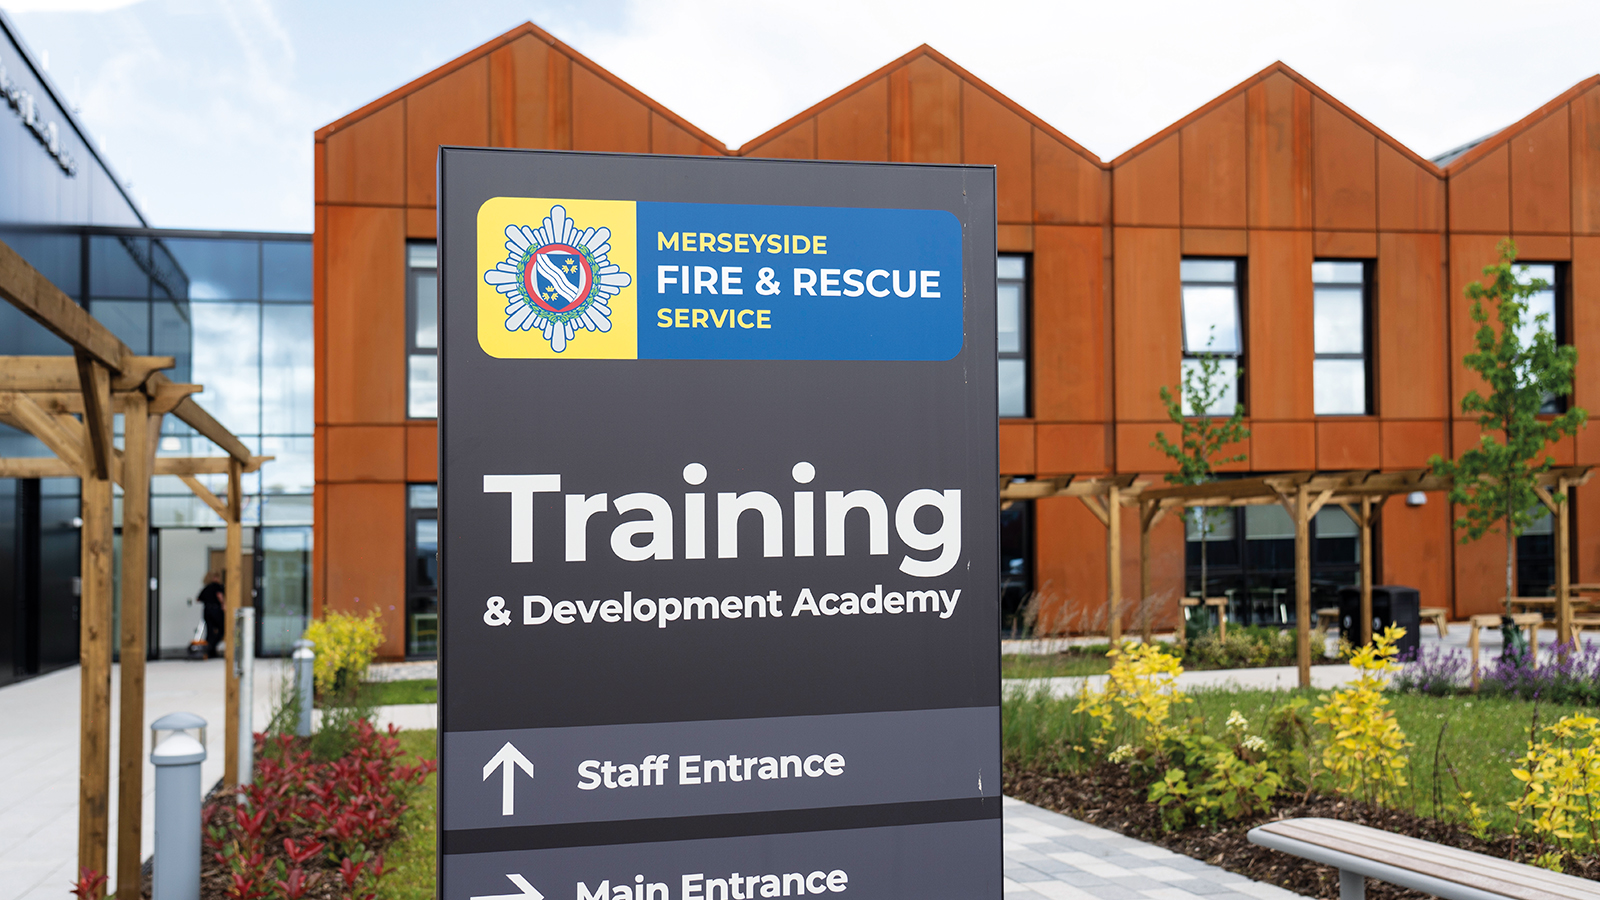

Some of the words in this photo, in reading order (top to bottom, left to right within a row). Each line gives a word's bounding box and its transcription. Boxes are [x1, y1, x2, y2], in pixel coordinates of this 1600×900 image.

[657, 231, 828, 255] MERSEYSIDE
[657, 265, 744, 295] FIRE
[755, 266, 782, 296] &
[793, 267, 941, 299] RESCUE
[657, 307, 772, 329] SERVICE
[483, 461, 962, 577] Training
[483, 595, 512, 627] &
[523, 589, 783, 628] Development
[791, 584, 962, 619] Academy
[577, 754, 670, 791] Staff
[678, 752, 846, 785] Entrance
[576, 874, 670, 900] Main
[681, 869, 848, 900] Entrance
